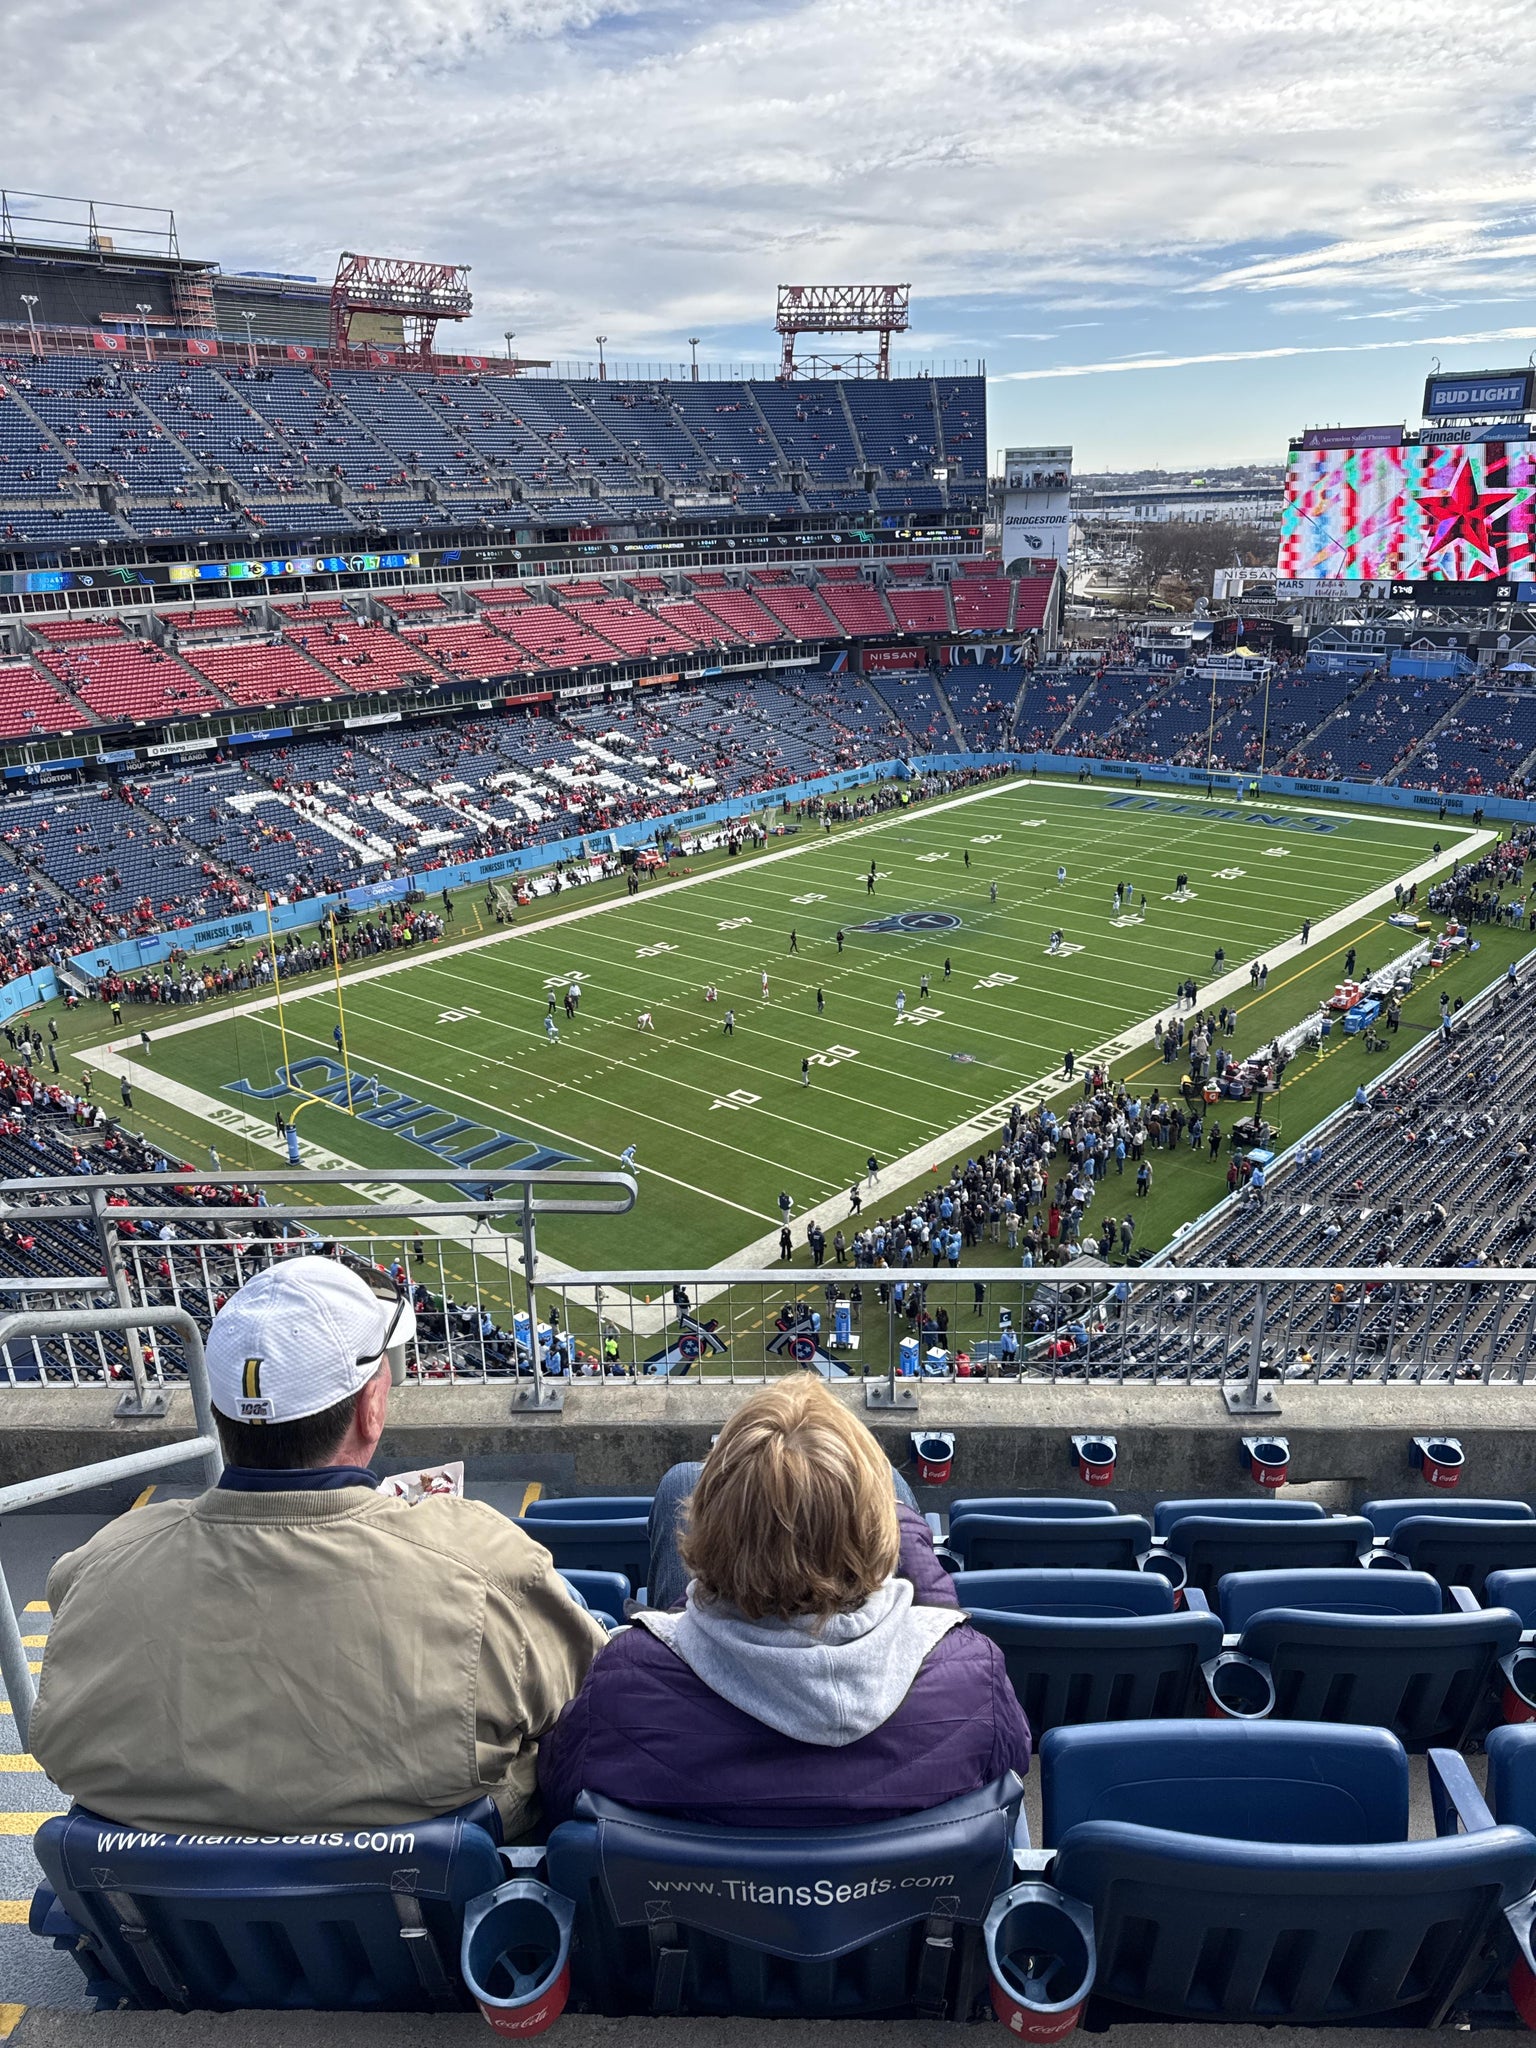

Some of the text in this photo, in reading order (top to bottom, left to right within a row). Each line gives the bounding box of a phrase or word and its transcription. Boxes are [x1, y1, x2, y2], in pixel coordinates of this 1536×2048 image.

[1435, 386, 1520, 405] BUD LIGHT
[1321, 433, 1391, 443] Ascension Saint Thomas
[1421, 429, 1471, 443] Pinnacle
[1005, 515, 1068, 525] BRIDGESTONE
[285, 562, 294, 574] 0
[316, 559, 325, 571] 0
[1224, 570, 1277, 579] NISSAN
[1278, 580, 1305, 589] MARS
[1241, 597, 1276, 605] PATHFINDER
[869, 650, 918, 661] NISSAN
[180, 753, 207, 763] BLANDA
[40, 773, 72, 785] NORTON
[1294, 782, 1340, 795] TENNESSEE TOUGH
[1414, 795, 1464, 808] TENNESSEE TOUGH
[1104, 793, 1354, 834] TITANS
[970, 834, 999, 844] 20
[915, 852, 946, 863] 30
[479, 863, 505, 875] TENNESSEE
[1212, 867, 1247, 880] 20
[790, 892, 828, 906] 50
[722, 915, 750, 930] 40
[1110, 914, 1145, 928] 40
[193, 926, 231, 944] TENNESSEE
[641, 941, 678, 957] 30
[549, 970, 591, 988] 20
[979, 972, 1019, 988] 40
[443, 1006, 481, 1023] 10
[899, 1005, 945, 1026] 30
[807, 1044, 860, 1067] 20
[967, 1041, 1133, 1132] INSPIRE CHANGE
[712, 1088, 763, 1111] 10
[208, 1108, 246, 1126] US
[211, 1056, 593, 1202] TITANS
[244, 1124, 276, 1140] OF
[1002, 1314, 1009, 1323] C
[648, 1873, 956, 1906] www.TitansSeats.com
